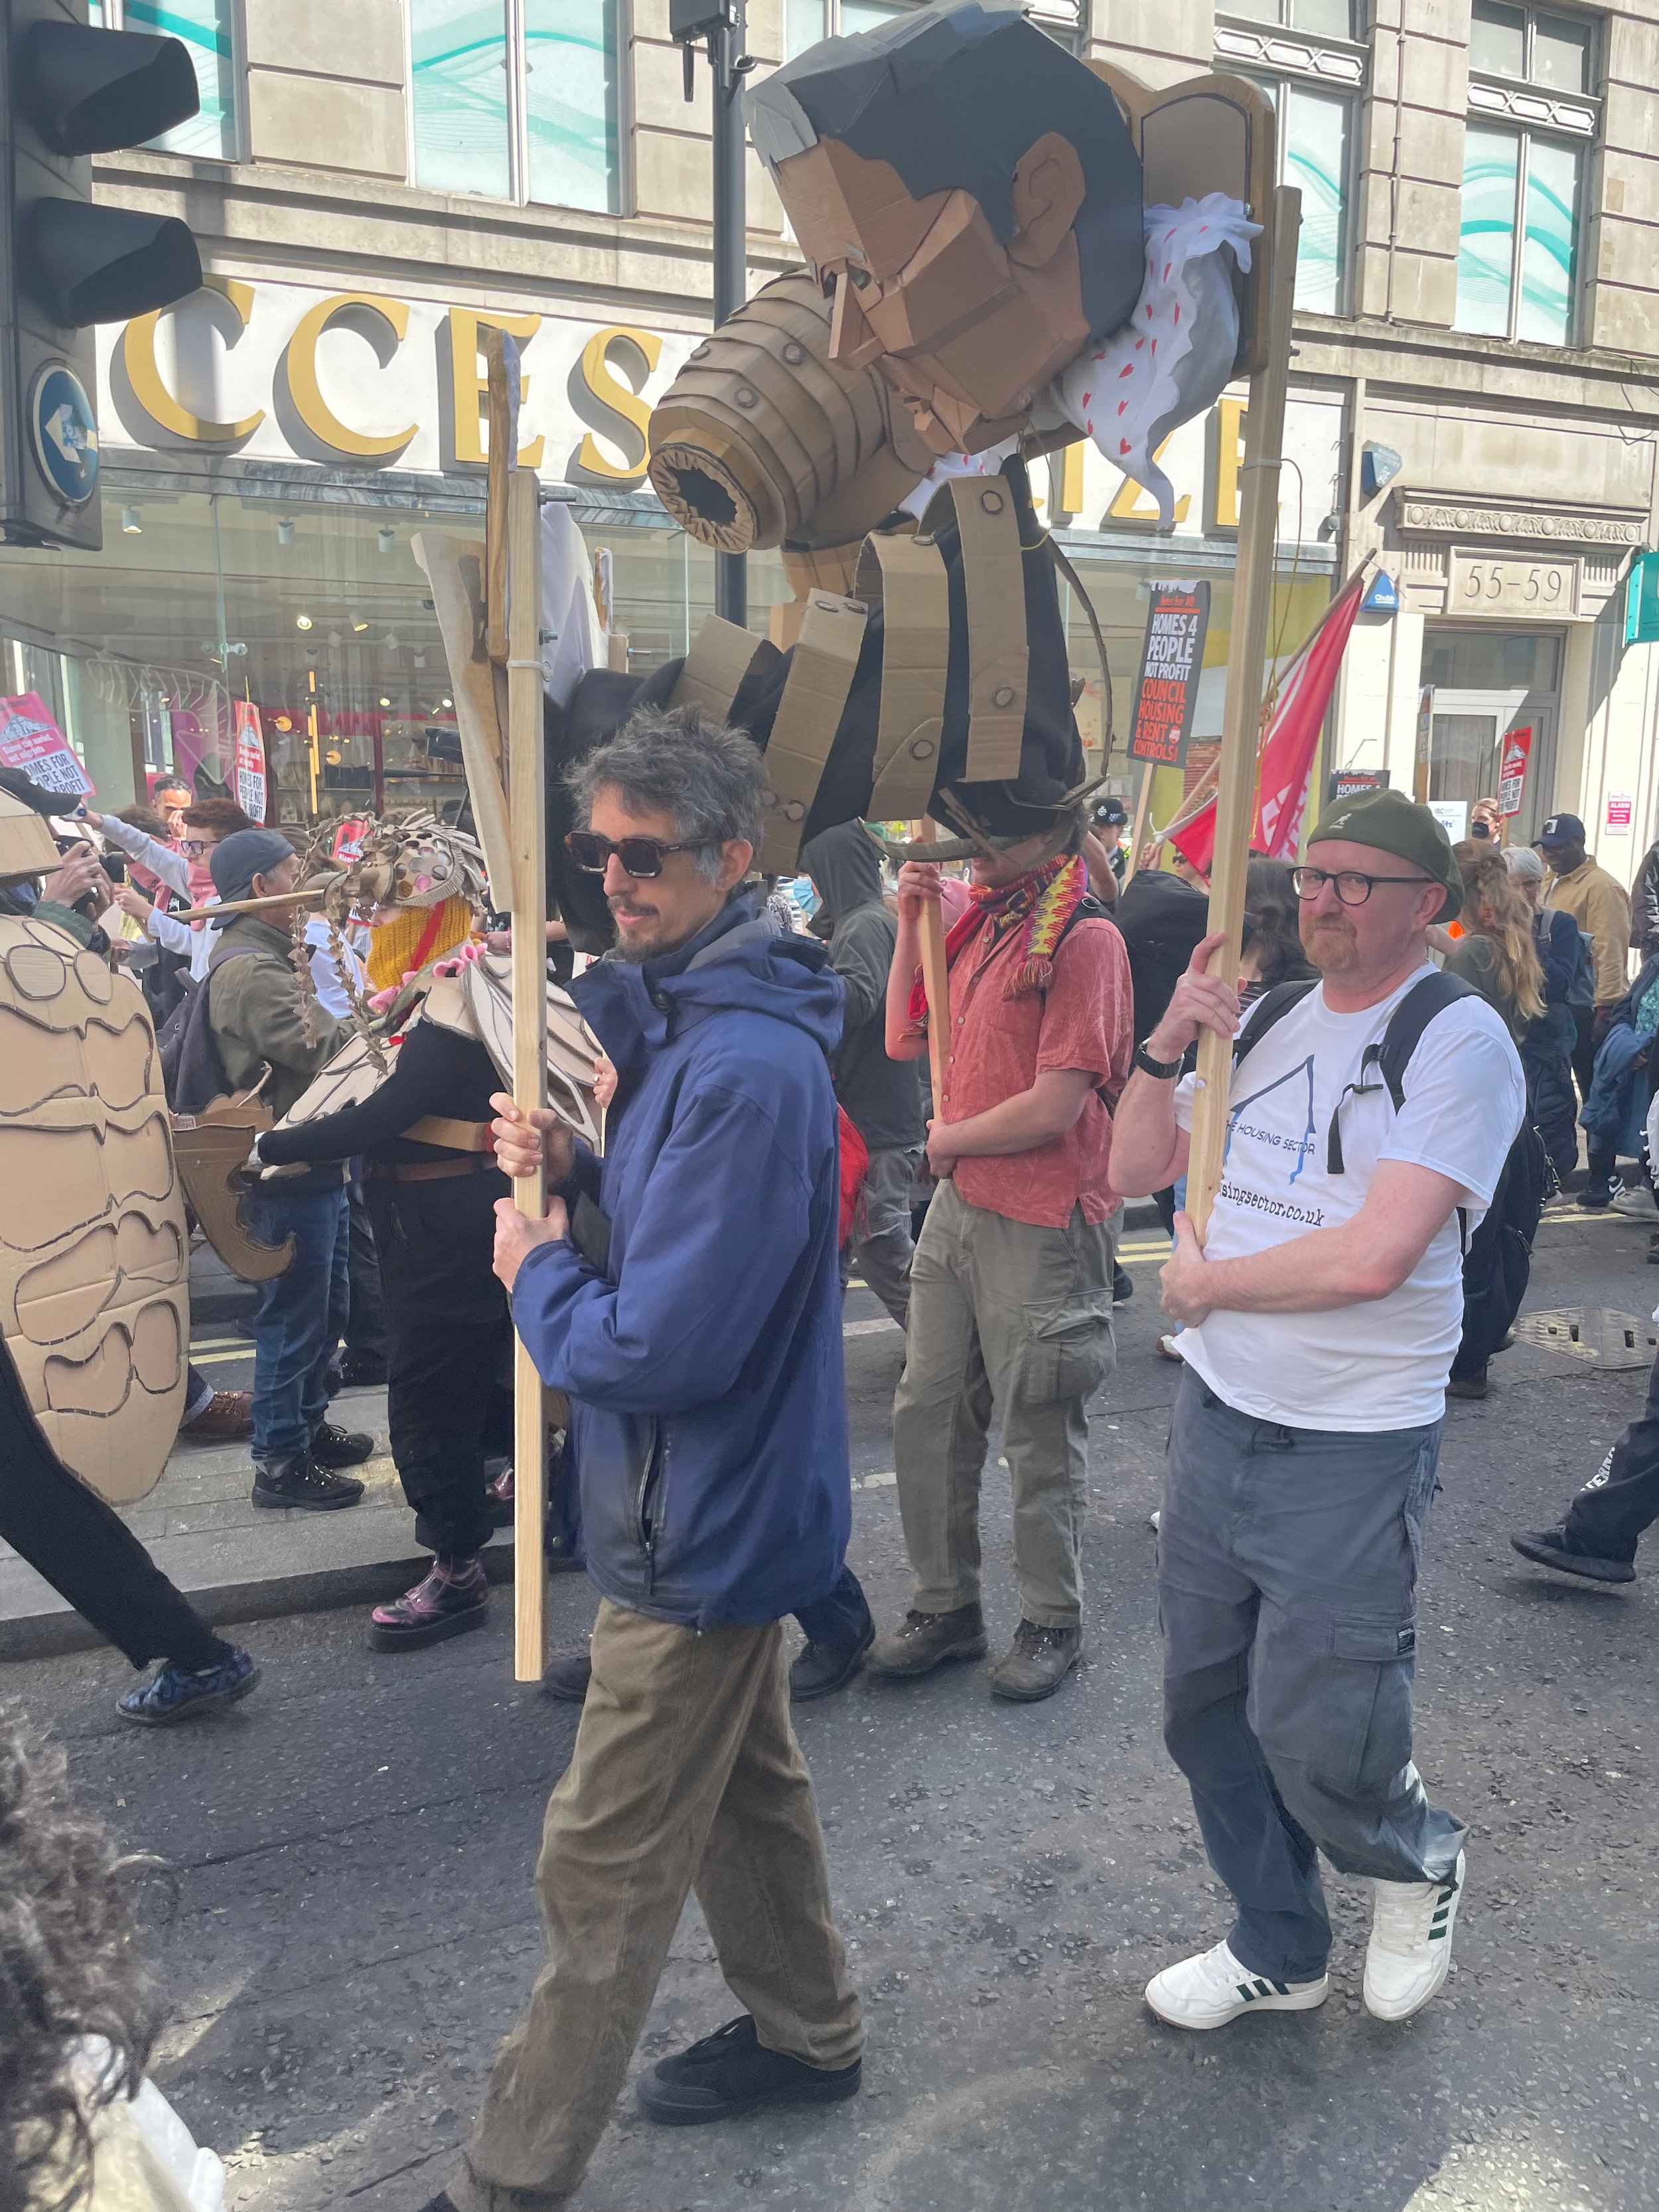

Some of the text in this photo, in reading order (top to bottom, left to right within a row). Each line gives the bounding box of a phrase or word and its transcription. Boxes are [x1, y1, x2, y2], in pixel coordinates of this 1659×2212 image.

[1464, 565, 1561, 602] 55-59
[1151, 614, 1198, 636] HOMES 4
[1147, 635, 1195, 664] PEOPLE
[1144, 661, 1191, 681] NOT PROFIT
[1141, 678, 1186, 703] COUNCIL
[1138, 699, 1185, 725] HOUSING
[1135, 719, 1142, 738] &
[1142, 721, 1168, 743] RENT
[22, 754, 70, 776] OMES FOR
[36, 765, 79, 788] OPLE NOT
[253, 775, 262, 790] FOR
[254, 790, 263, 805] NOT
[1236, 1123, 1281, 1146] HOUSING
[1282, 1138, 1315, 1155] SECTOR
[1220, 1181, 1325, 1227] singsector.co.uk
